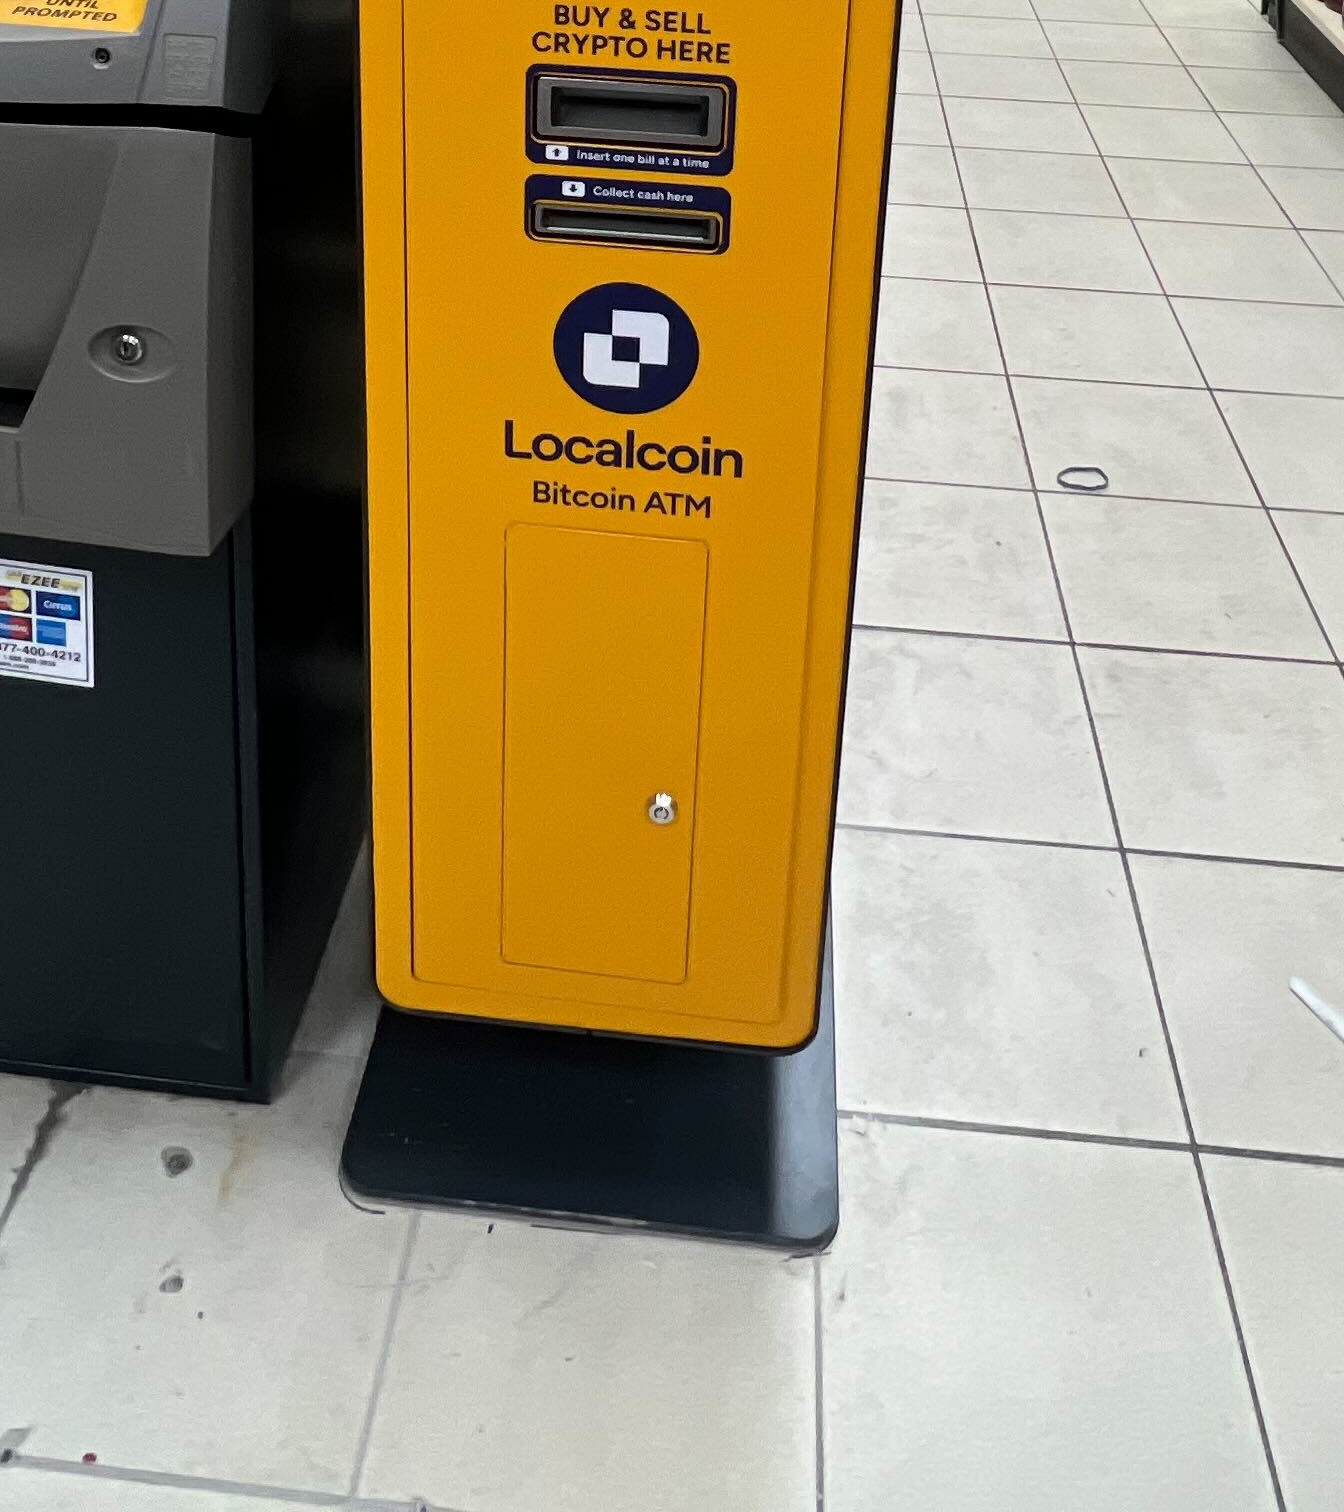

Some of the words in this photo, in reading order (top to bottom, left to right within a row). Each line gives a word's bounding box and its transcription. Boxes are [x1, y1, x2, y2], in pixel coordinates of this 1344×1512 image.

[11, 5, 118, 22] PROMPTED
[554, 4, 610, 28] BUY
[618, 7, 637, 30] &
[644, 9, 712, 34] SELL
[531, 31, 648, 59] CRYPTO
[656, 39, 731, 64] HERE
[575, 148, 611, 163] Insert
[612, 153, 635, 164] one
[637, 153, 655, 166] bill
[657, 155, 670, 166] at
[682, 156, 710, 169] time
[592, 185, 635, 199] Collect
[637, 188, 665, 201] cash
[666, 190, 694, 203] here
[504, 419, 744, 479] Localcoin
[532, 480, 636, 512] Bitcoin
[643, 490, 712, 519] ATM
[20, 573, 61, 589] EZEE
